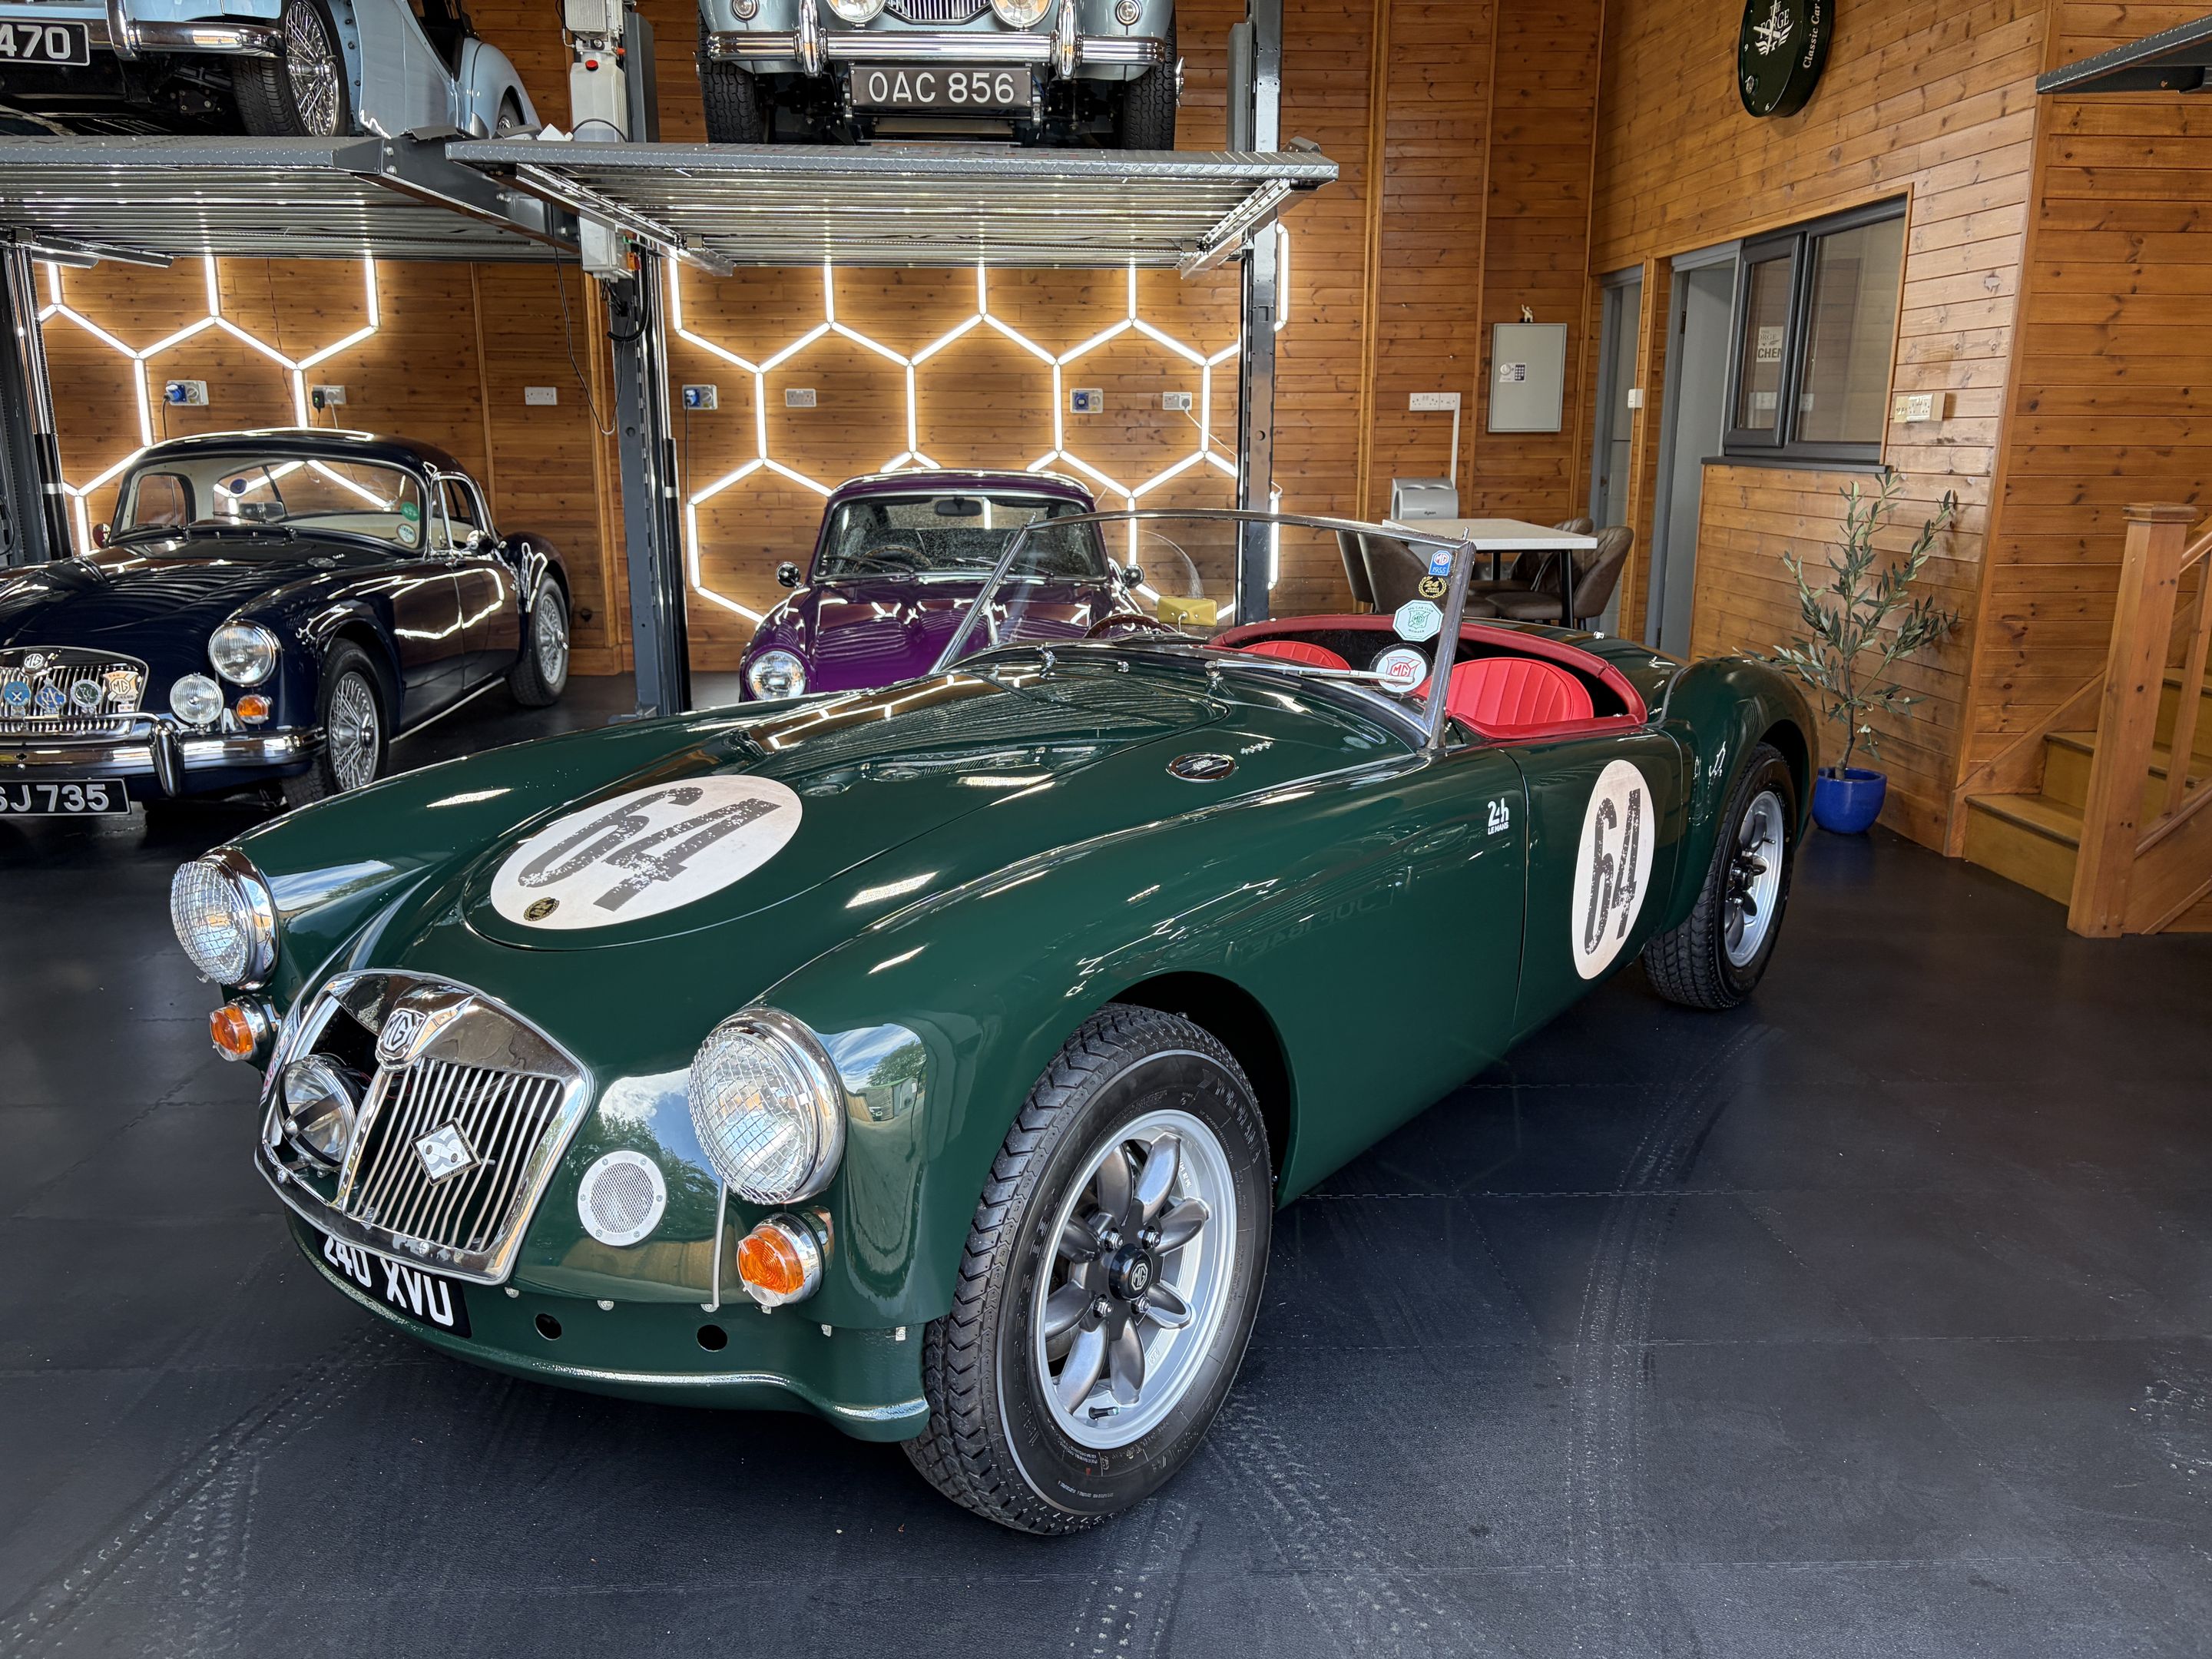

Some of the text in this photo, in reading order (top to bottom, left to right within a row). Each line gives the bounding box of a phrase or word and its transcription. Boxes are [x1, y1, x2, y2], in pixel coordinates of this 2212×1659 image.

[0, 24, 71, 59] 470
[1803, 28, 1819, 68] Classic
[869, 71, 1015, 103] OAC 856
[25, 653, 44, 669] MG
[1392, 664, 1410, 677] MG
[113, 680, 128, 693] MG
[36, 783, 109, 812] 735
[518, 787, 782, 912] 64
[1584, 788, 1641, 955] 64
[385, 1013, 411, 1048] MG
[380, 1257, 454, 1327] XVU
[1133, 1265, 1147, 1288] MG
